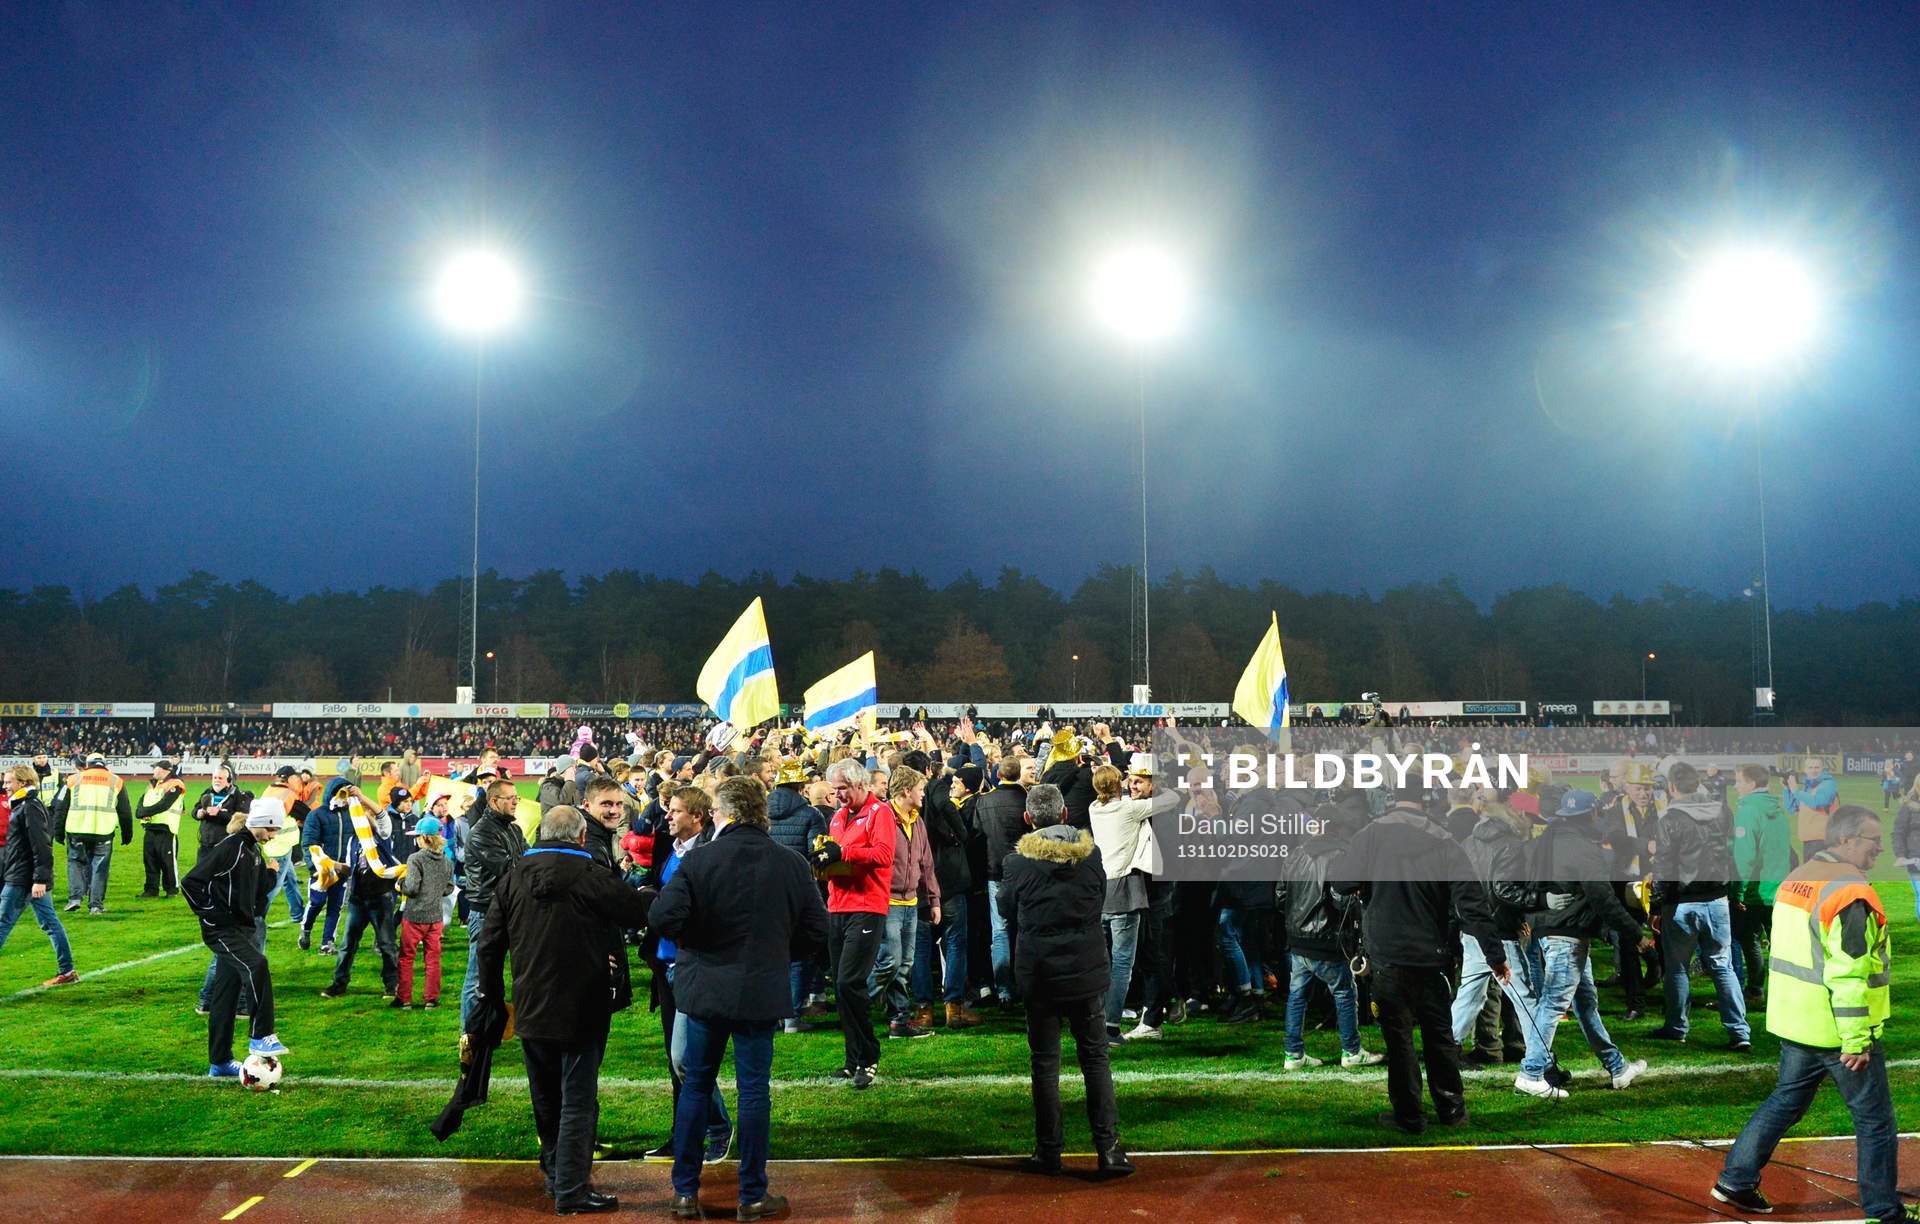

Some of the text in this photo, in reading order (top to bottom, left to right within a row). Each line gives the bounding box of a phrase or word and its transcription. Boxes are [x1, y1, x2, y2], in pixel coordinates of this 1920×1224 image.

[322, 703, 347, 713] FaBo
[356, 703, 382, 713] FaBo
[475, 707, 508, 715] BYGG
[1123, 704, 1163, 716] SKAB
